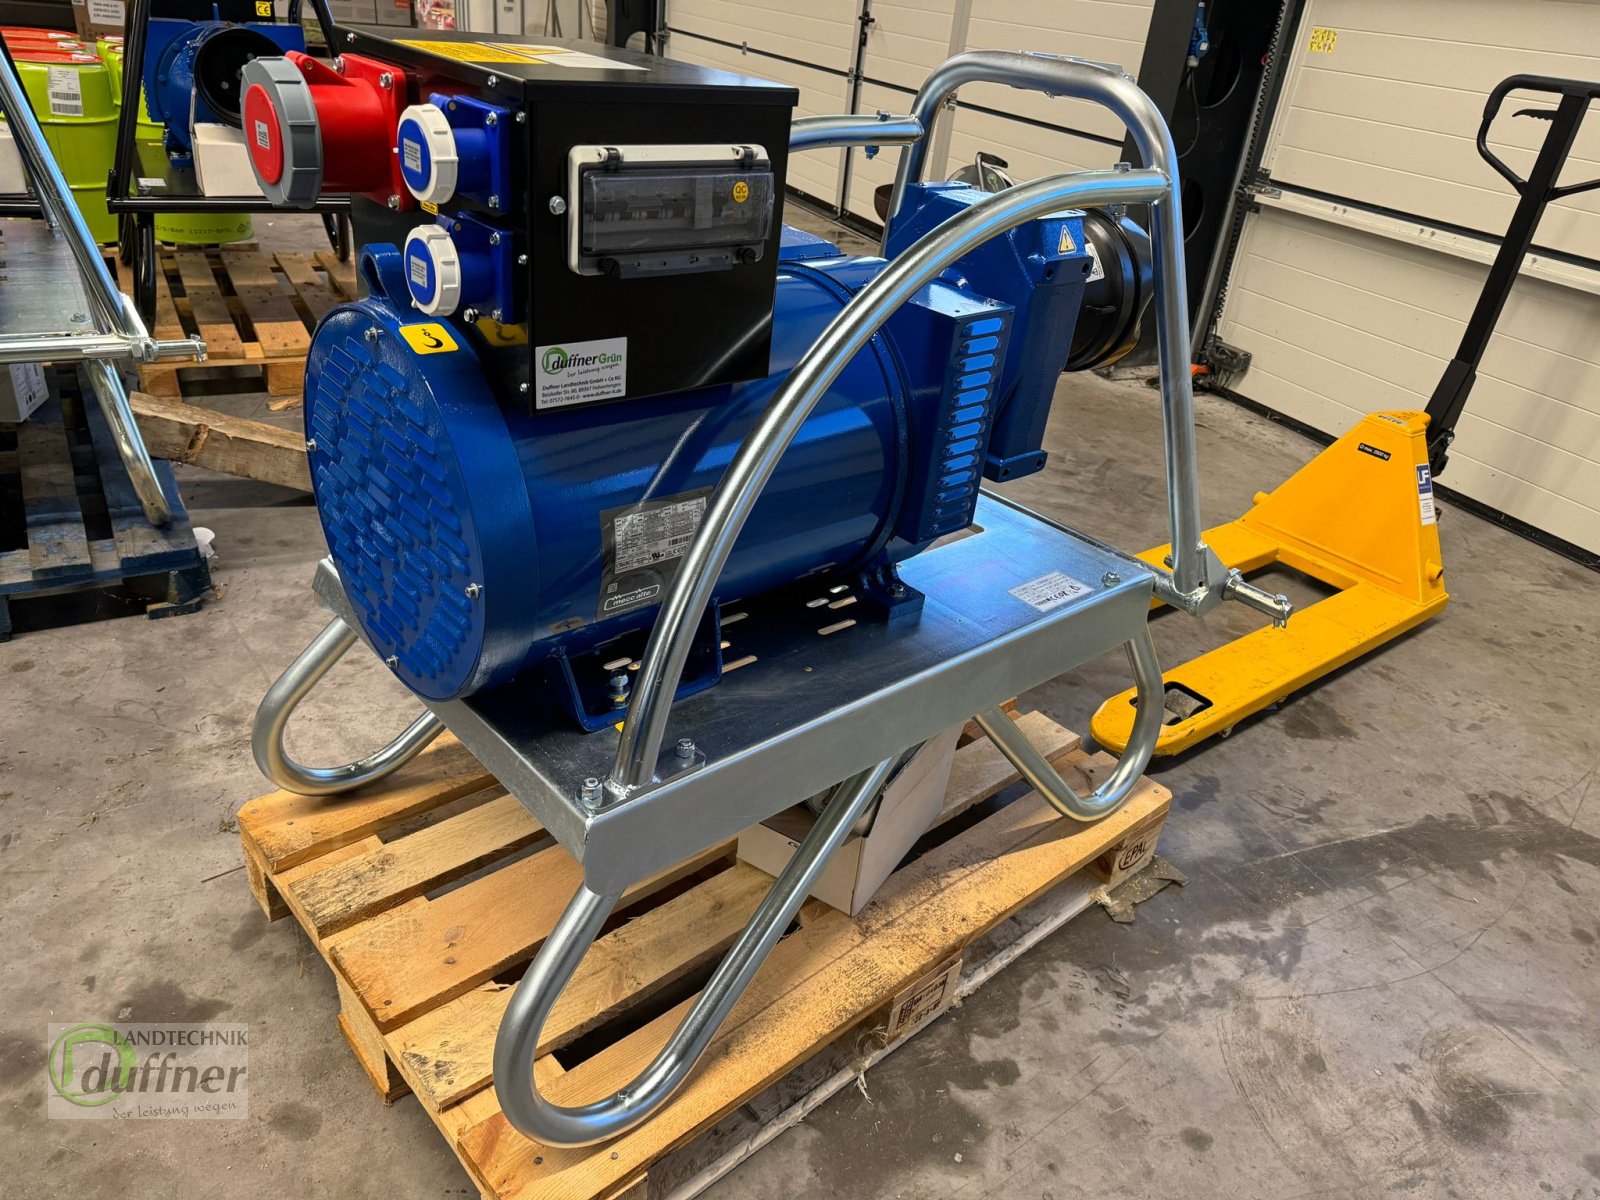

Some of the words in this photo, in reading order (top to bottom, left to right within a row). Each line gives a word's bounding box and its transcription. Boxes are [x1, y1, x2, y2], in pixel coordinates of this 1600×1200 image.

[258, 6, 269, 15] CE
[735, 185, 746, 194] QC
[561, 379, 588, 389] Landtechnik
[1123, 842, 1146, 866] EPAL
